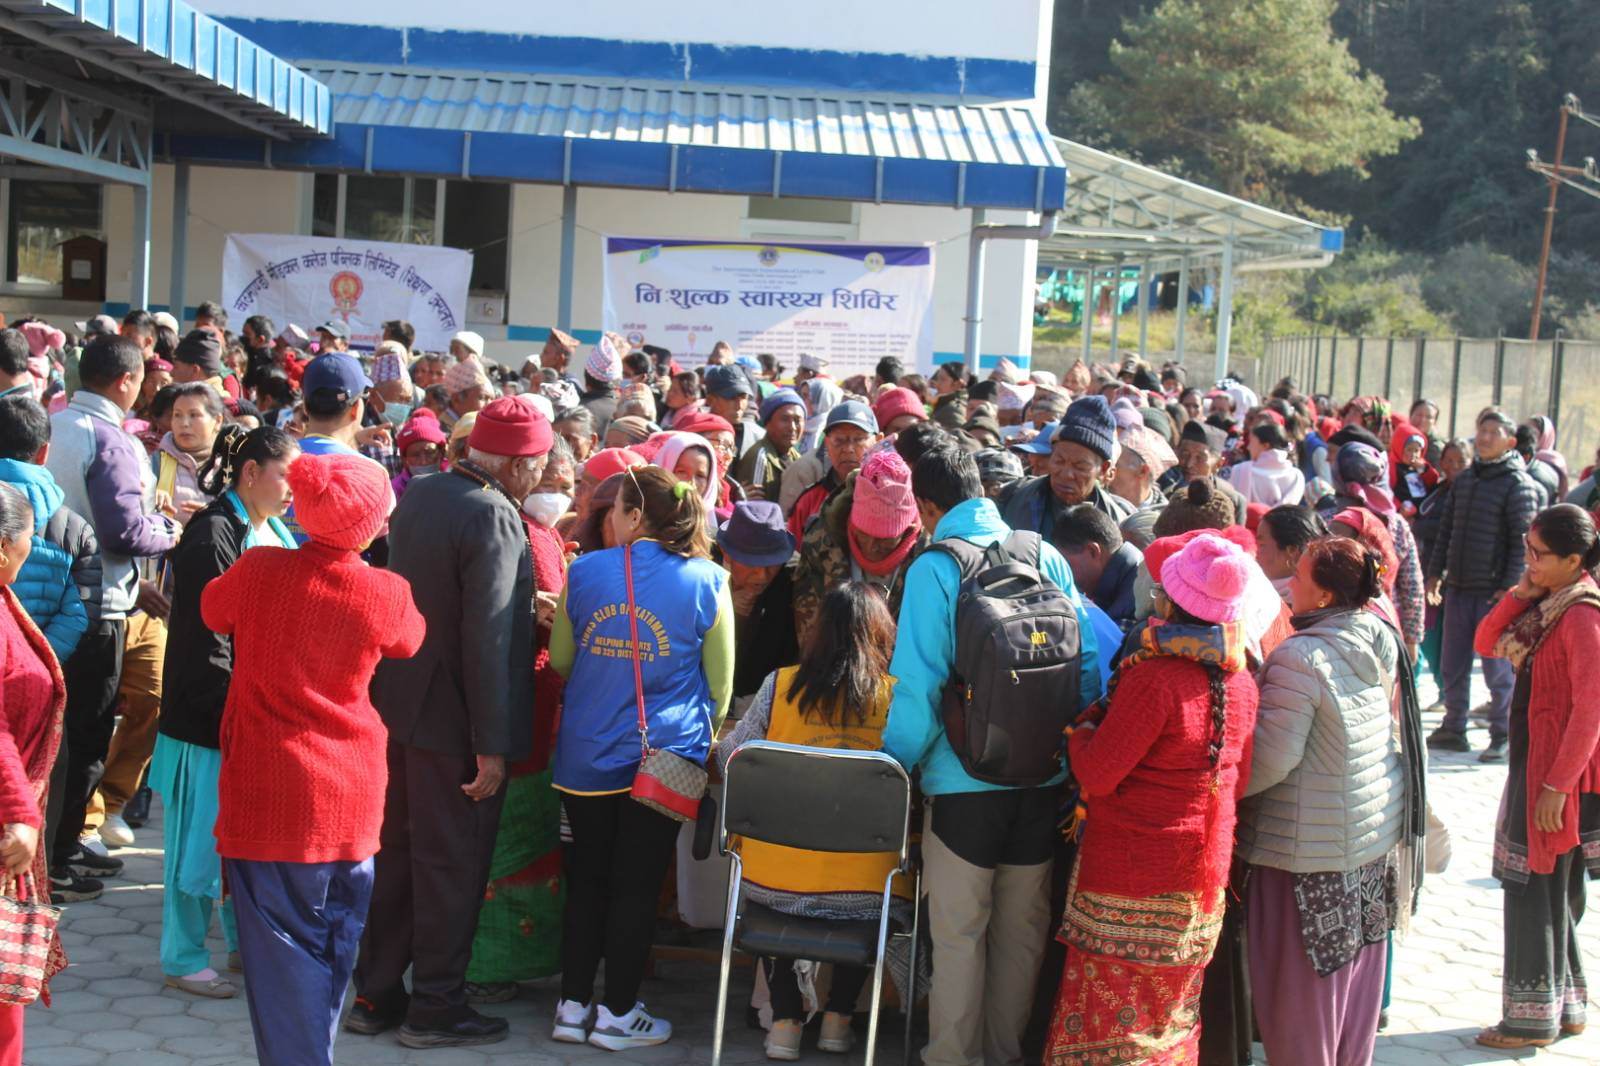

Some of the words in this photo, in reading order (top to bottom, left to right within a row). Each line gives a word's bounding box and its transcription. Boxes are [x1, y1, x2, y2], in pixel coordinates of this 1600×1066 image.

[330, 246, 364, 270] पब्लिक
[364, 249, 400, 279] लिमिटेड
[738, 290, 823, 308] स्वास्थ्य
[832, 287, 899, 311] शिविर
[593, 604, 617, 622] CLUB
[635, 605, 670, 656] KATHMANDU
[617, 649, 647, 661] DISTCT
[626, 640, 652, 651] HERTS
